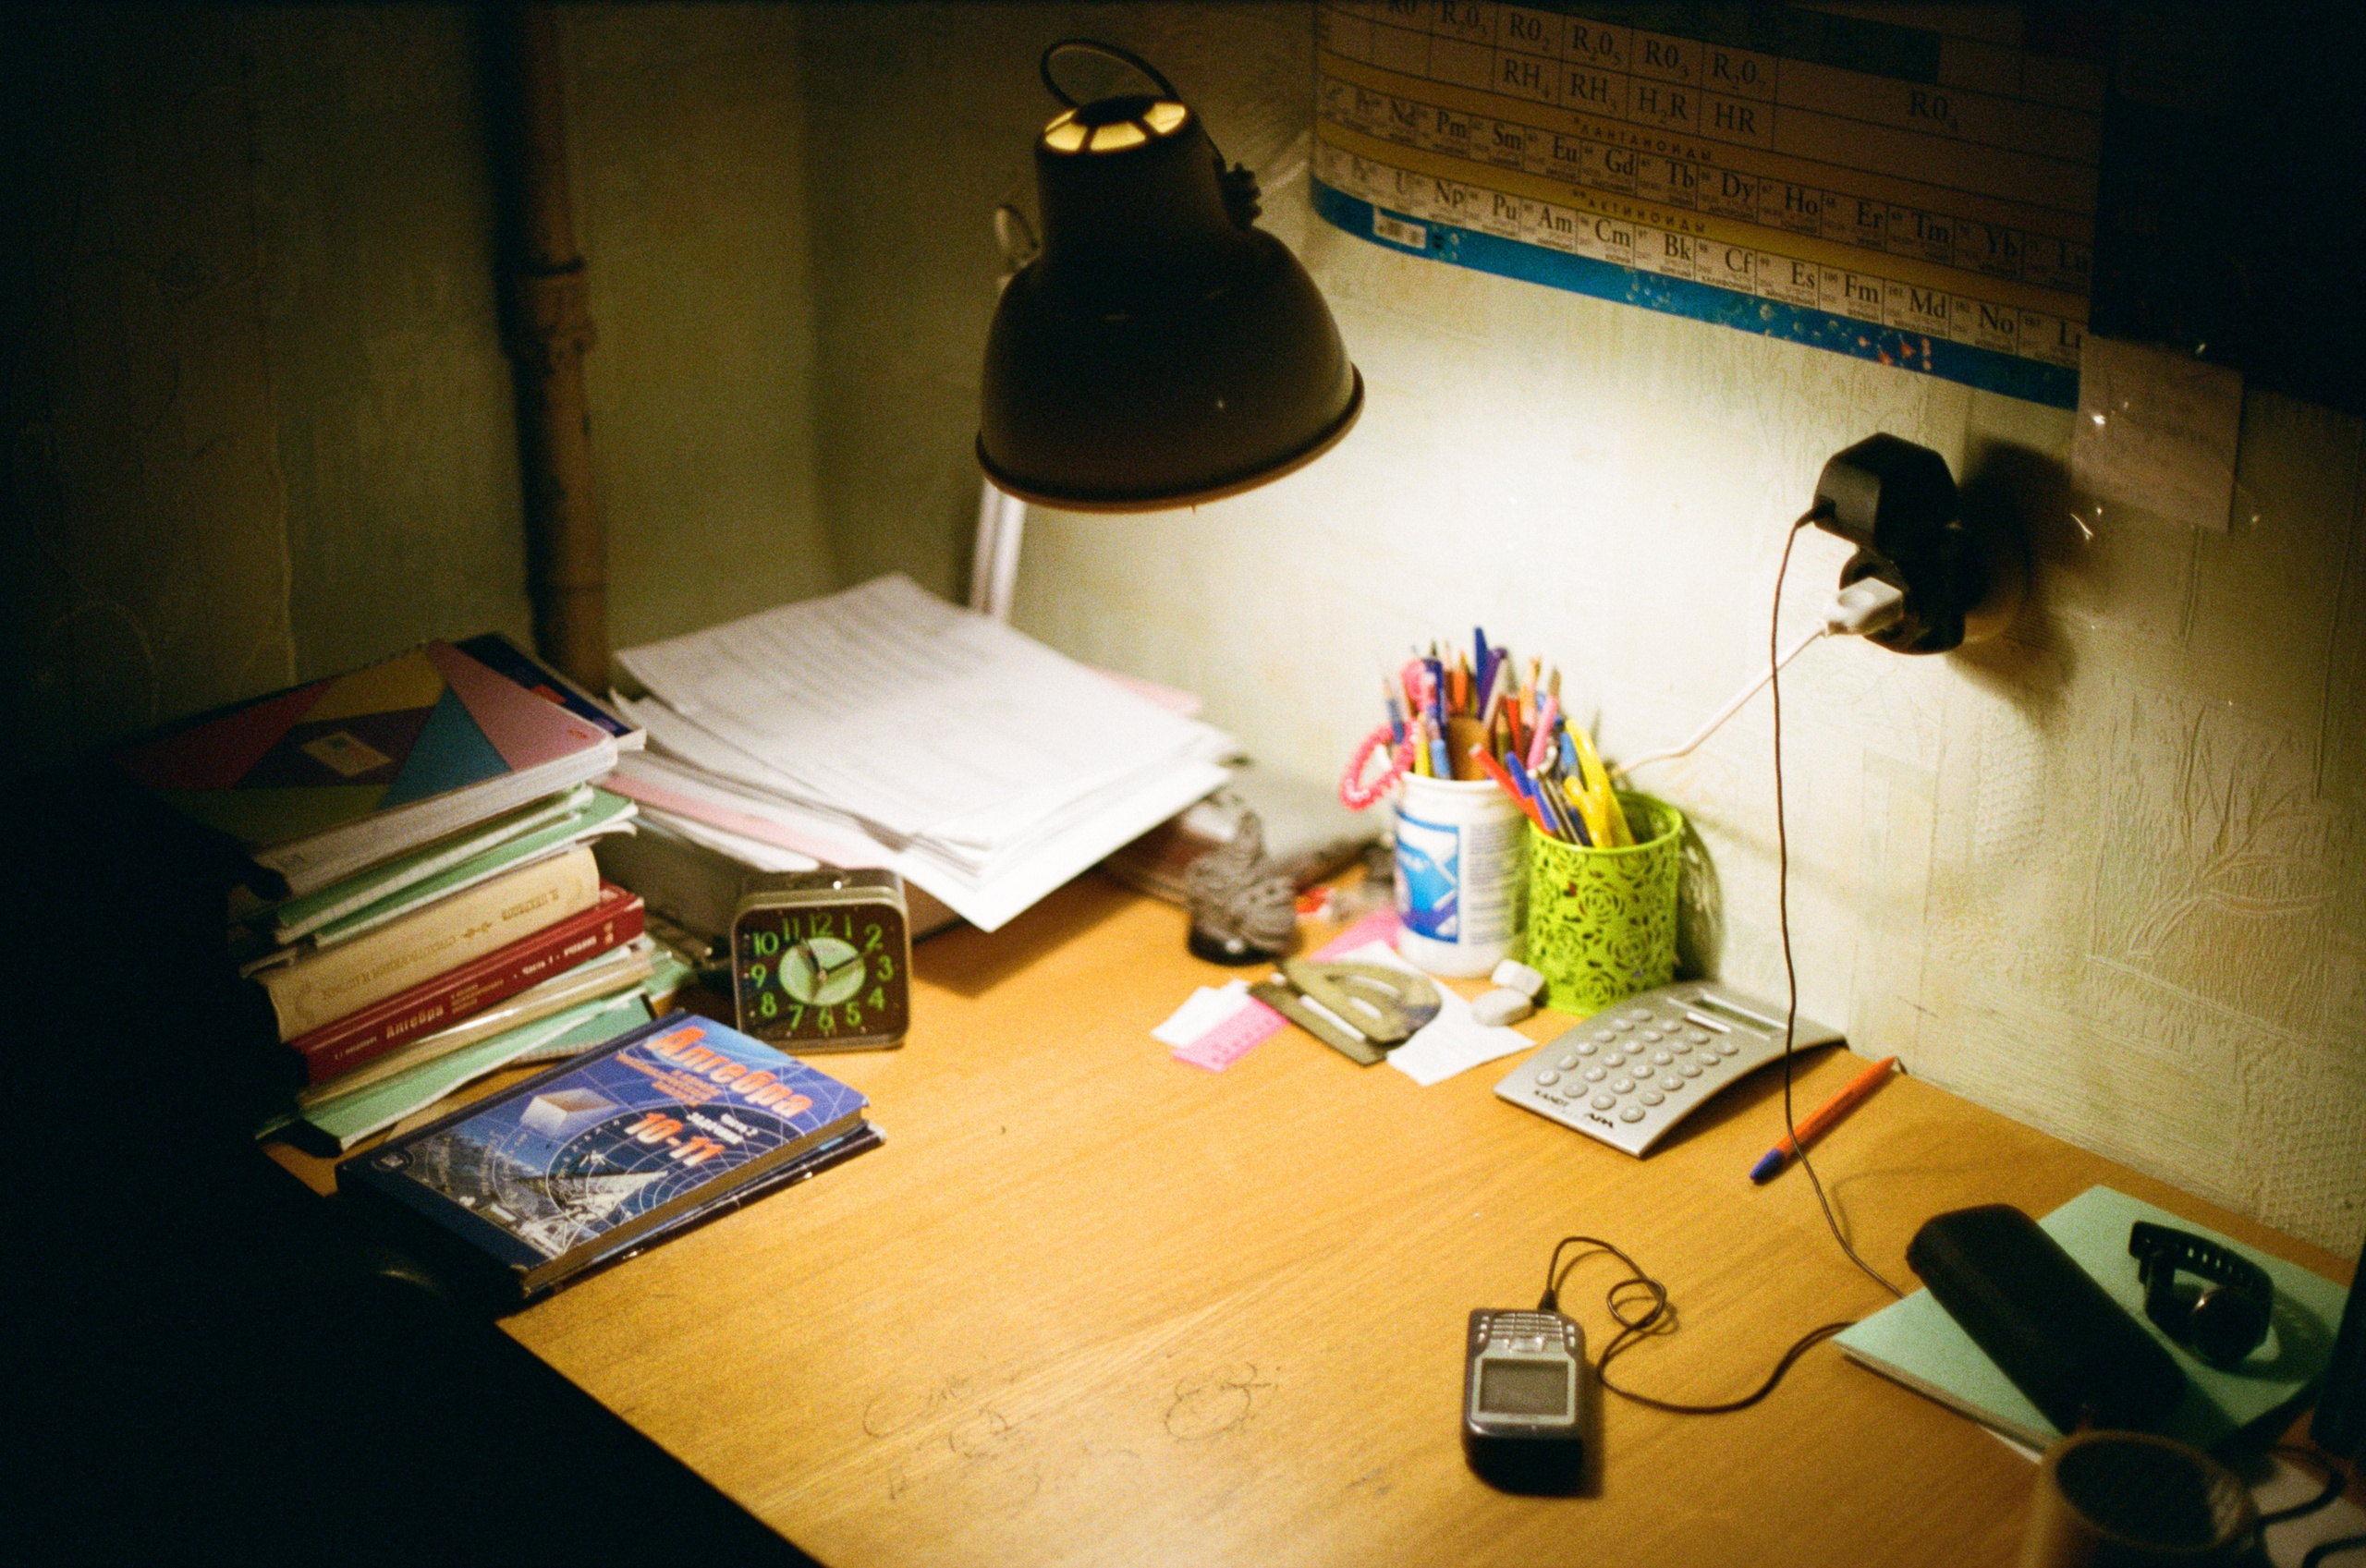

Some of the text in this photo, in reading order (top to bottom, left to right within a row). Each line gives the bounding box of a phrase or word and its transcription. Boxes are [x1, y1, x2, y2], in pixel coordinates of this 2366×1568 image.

[1715, 102, 1755, 134] HR
[1437, 111, 1467, 138] Pm
[1493, 122, 1522, 151] Sm
[1554, 136, 1578, 163] Eu
[1605, 149, 1634, 176] Gd
[1665, 160, 1694, 188] Tb
[1722, 171, 1750, 202] Dy
[1786, 186, 1818, 215] Ho
[1858, 201, 1884, 229] Er
[1913, 211, 1948, 244] Tm
[1986, 225, 2018, 258] Yb
[1435, 180, 1465, 208] Np
[1494, 194, 1517, 220] Pu
[1538, 207, 1572, 234] Am
[1595, 218, 1631, 247] Cm
[1665, 234, 1691, 261] Bk
[1725, 247, 1753, 273] Cf
[1791, 261, 1815, 288] Es
[1845, 273, 1879, 303] Fm
[1909, 287, 1946, 318] Md
[1979, 303, 2014, 334] No
[782, 917, 800, 942] 11
[809, 911, 834, 937] 12
[845, 914, 853, 939] 1
[864, 924, 884, 951] 2
[752, 931, 779, 957] 10
[750, 963, 767, 989] 9
[877, 954, 894, 981] 3
[761, 991, 778, 1017] 8
[867, 986, 885, 1011] 4
[384, 1003, 445, 1041] Алгебра
[788, 1003, 805, 1030] 7
[818, 1006, 835, 1031] 6
[846, 1000, 862, 1027] 5
[644, 1025, 813, 1119] Алгебра
[624, 1112, 727, 1167] 10-11
